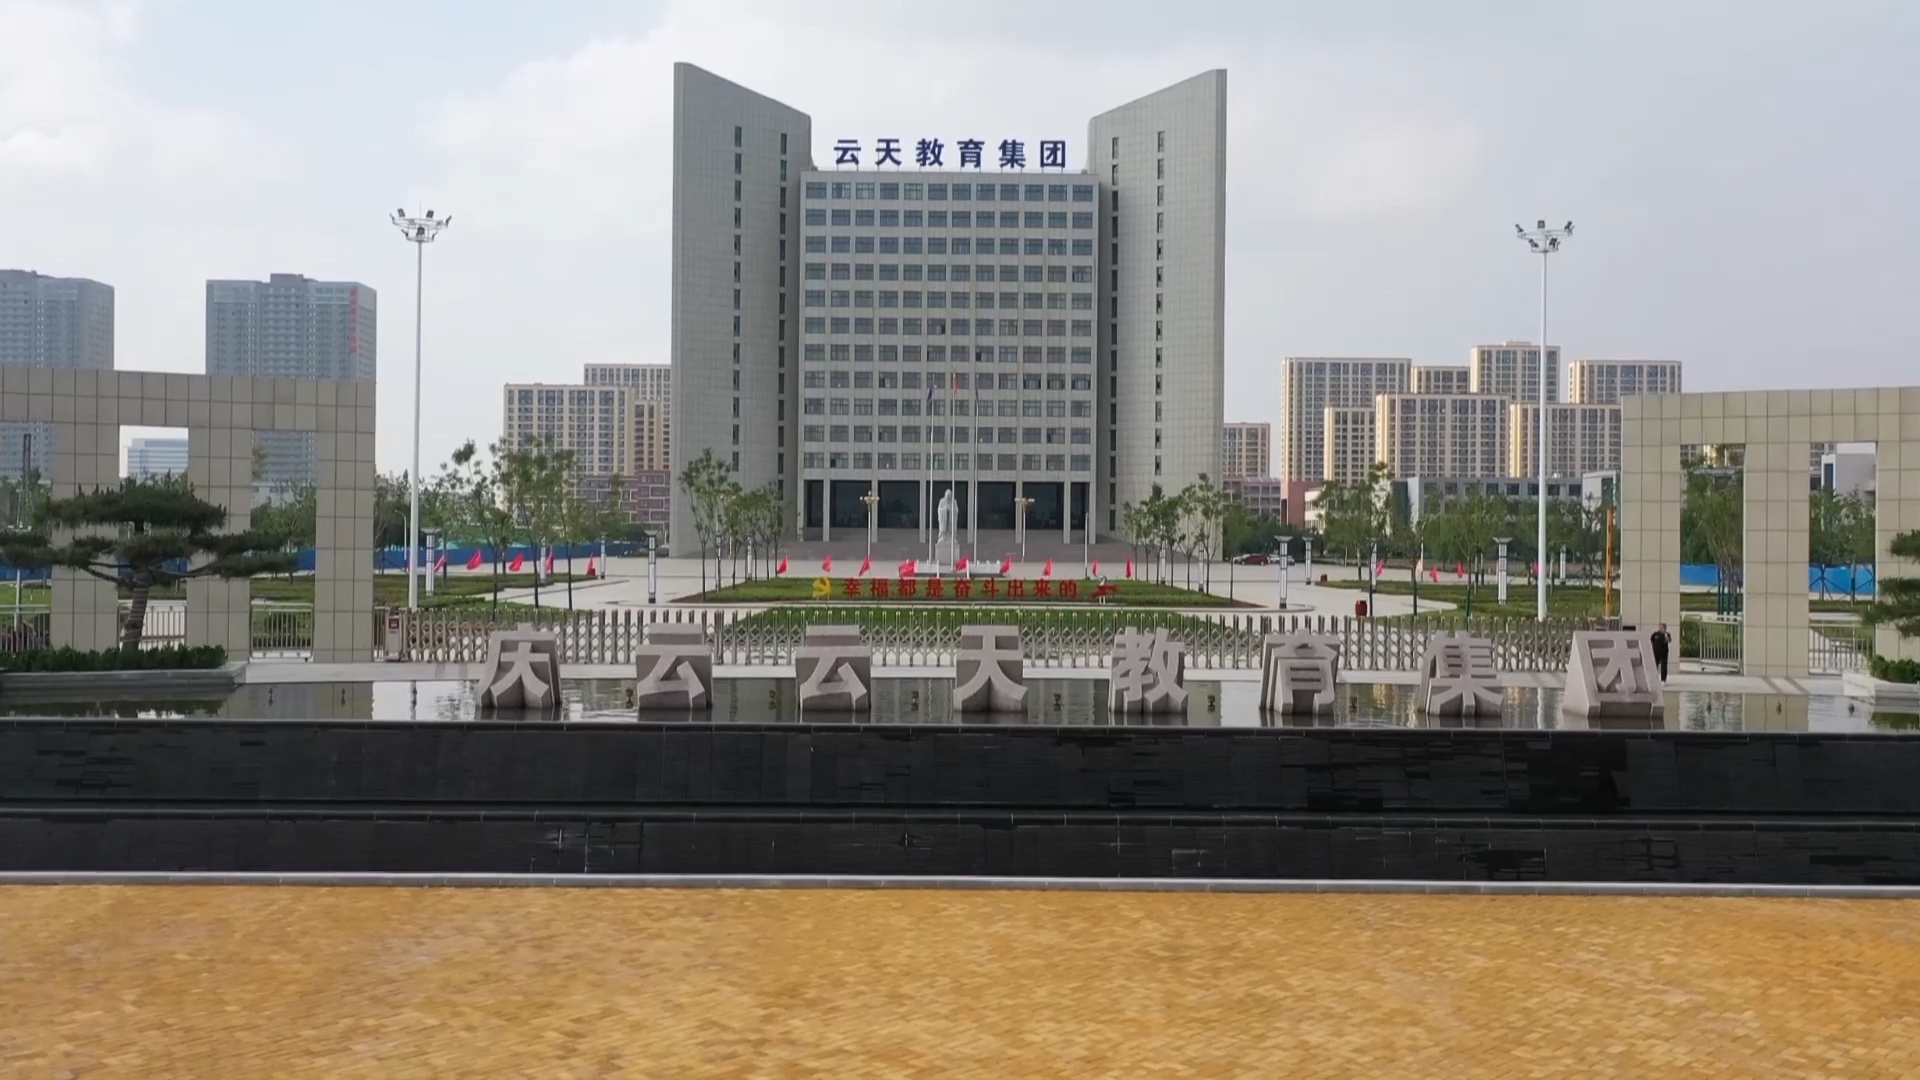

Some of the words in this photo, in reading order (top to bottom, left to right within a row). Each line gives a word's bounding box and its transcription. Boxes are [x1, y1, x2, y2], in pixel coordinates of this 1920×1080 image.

[834, 138, 1066, 169] 云天教育集团
[842, 577, 1078, 597] 幸福都是奋斗出来的
[476, 622, 1665, 714] 庆云云天教育集团
